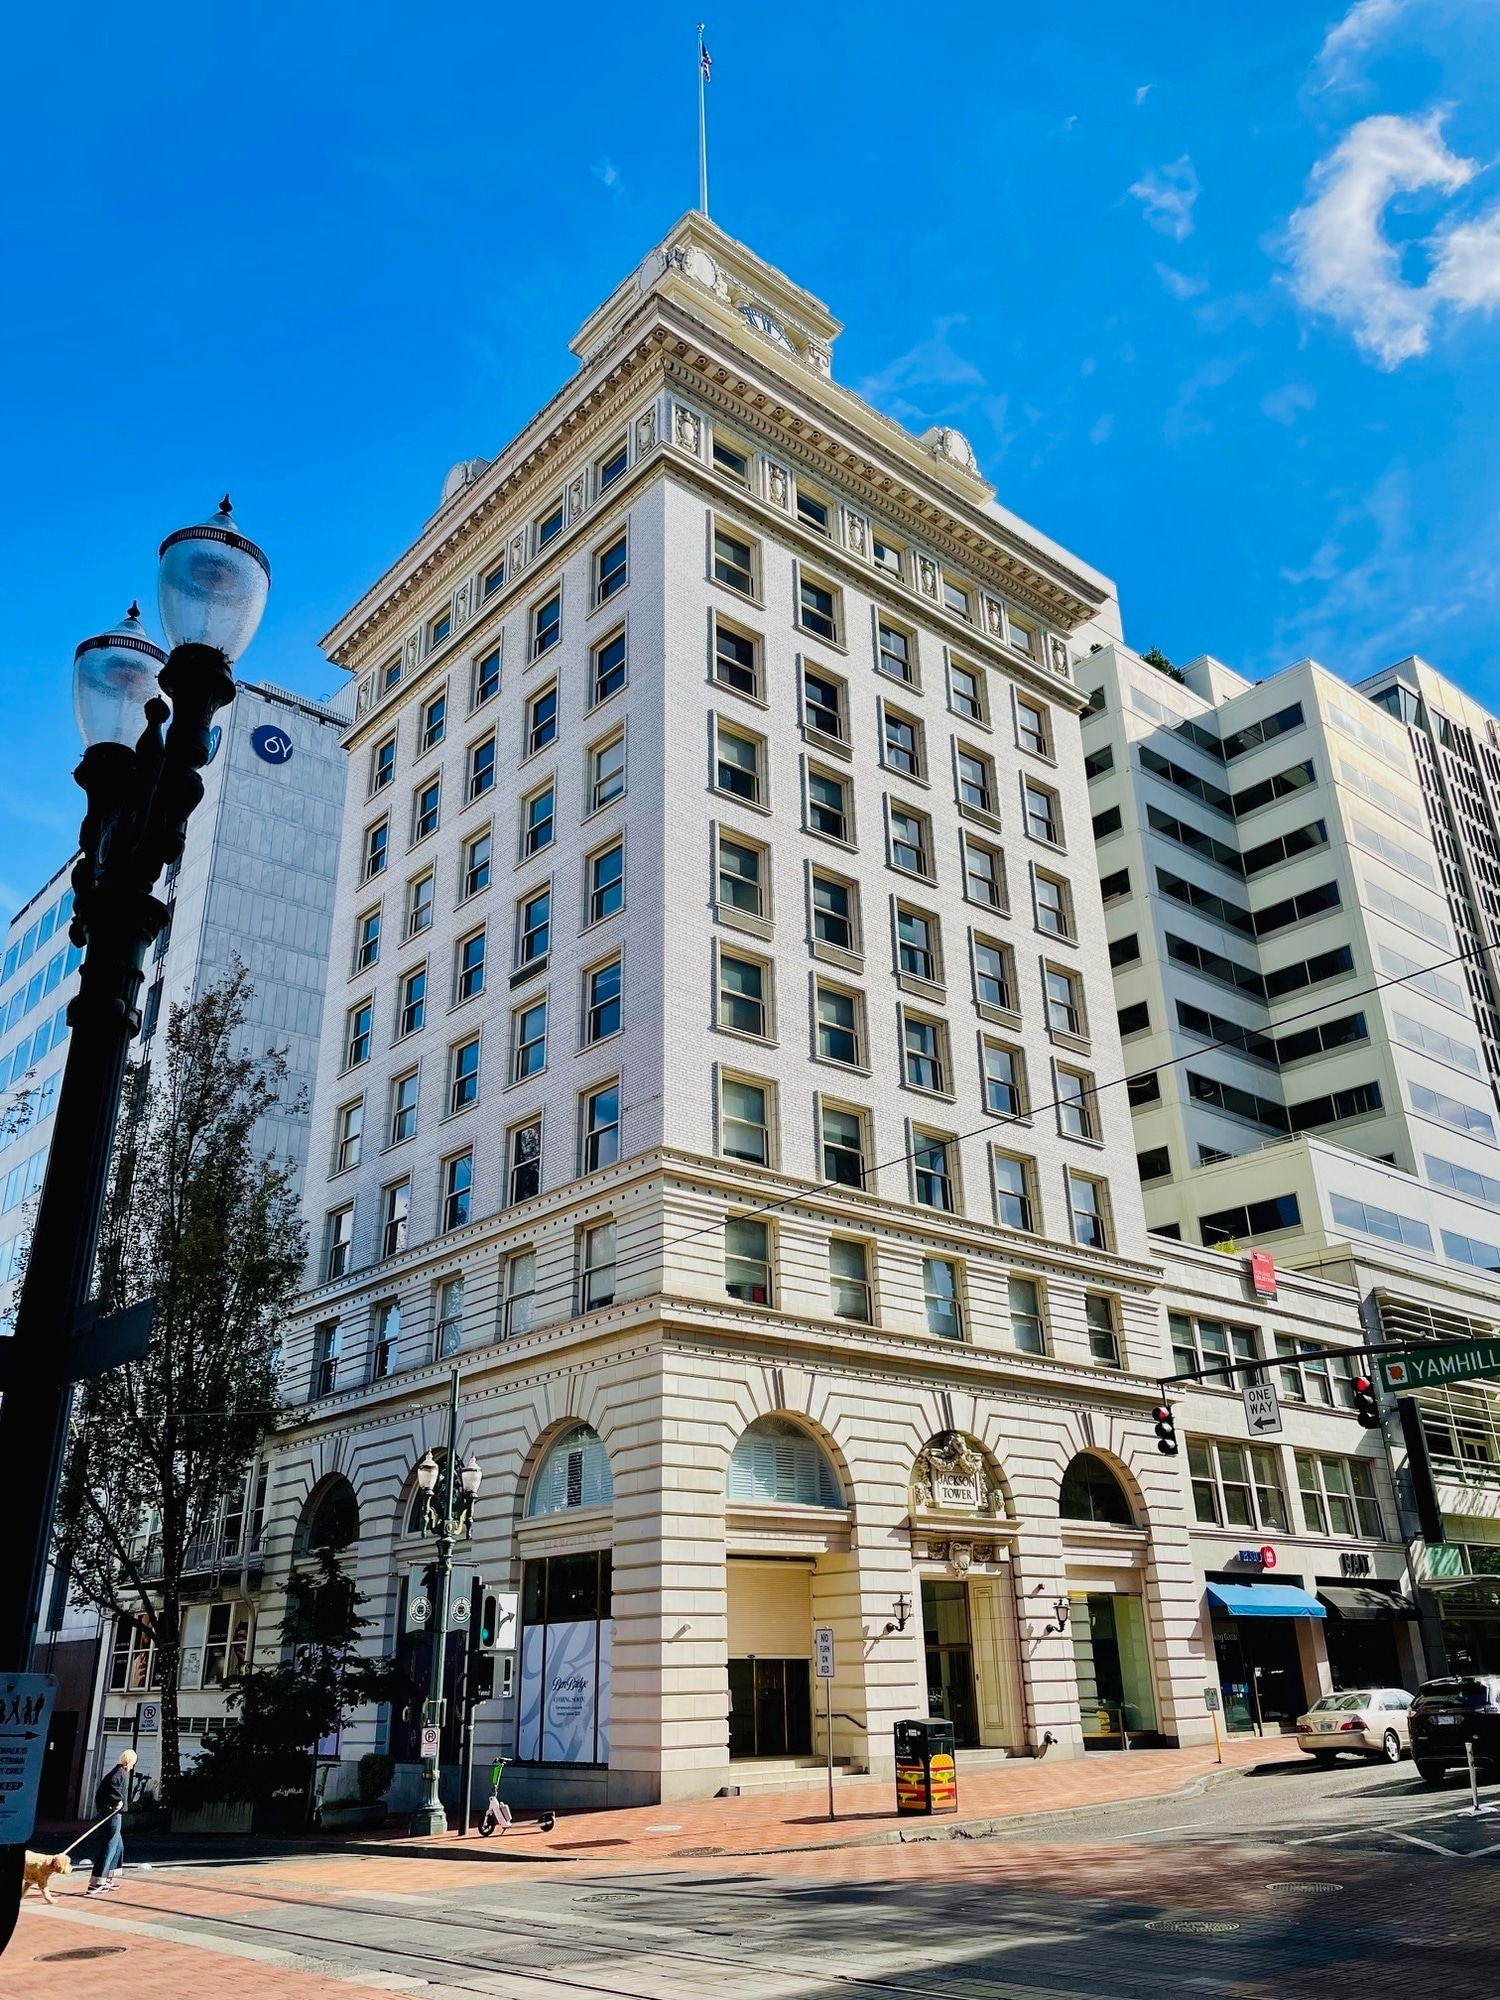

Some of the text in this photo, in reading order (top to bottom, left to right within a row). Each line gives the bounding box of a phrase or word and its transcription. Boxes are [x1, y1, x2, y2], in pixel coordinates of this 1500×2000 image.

[1411, 1349, 1500, 1379] YAMHILL
[1248, 1389, 1271, 1402] ONE
[1249, 1401, 1273, 1415] WAY
[938, 1473, 976, 1488] JACKSON
[941, 1487, 973, 1500] TOWER
[820, 1633, 829, 1643] NO
[819, 1645, 830, 1653] TURN
[822, 1655, 829, 1663] ON
[821, 1665, 830, 1674] RED
[0, 1781, 24, 1791] KEEP
